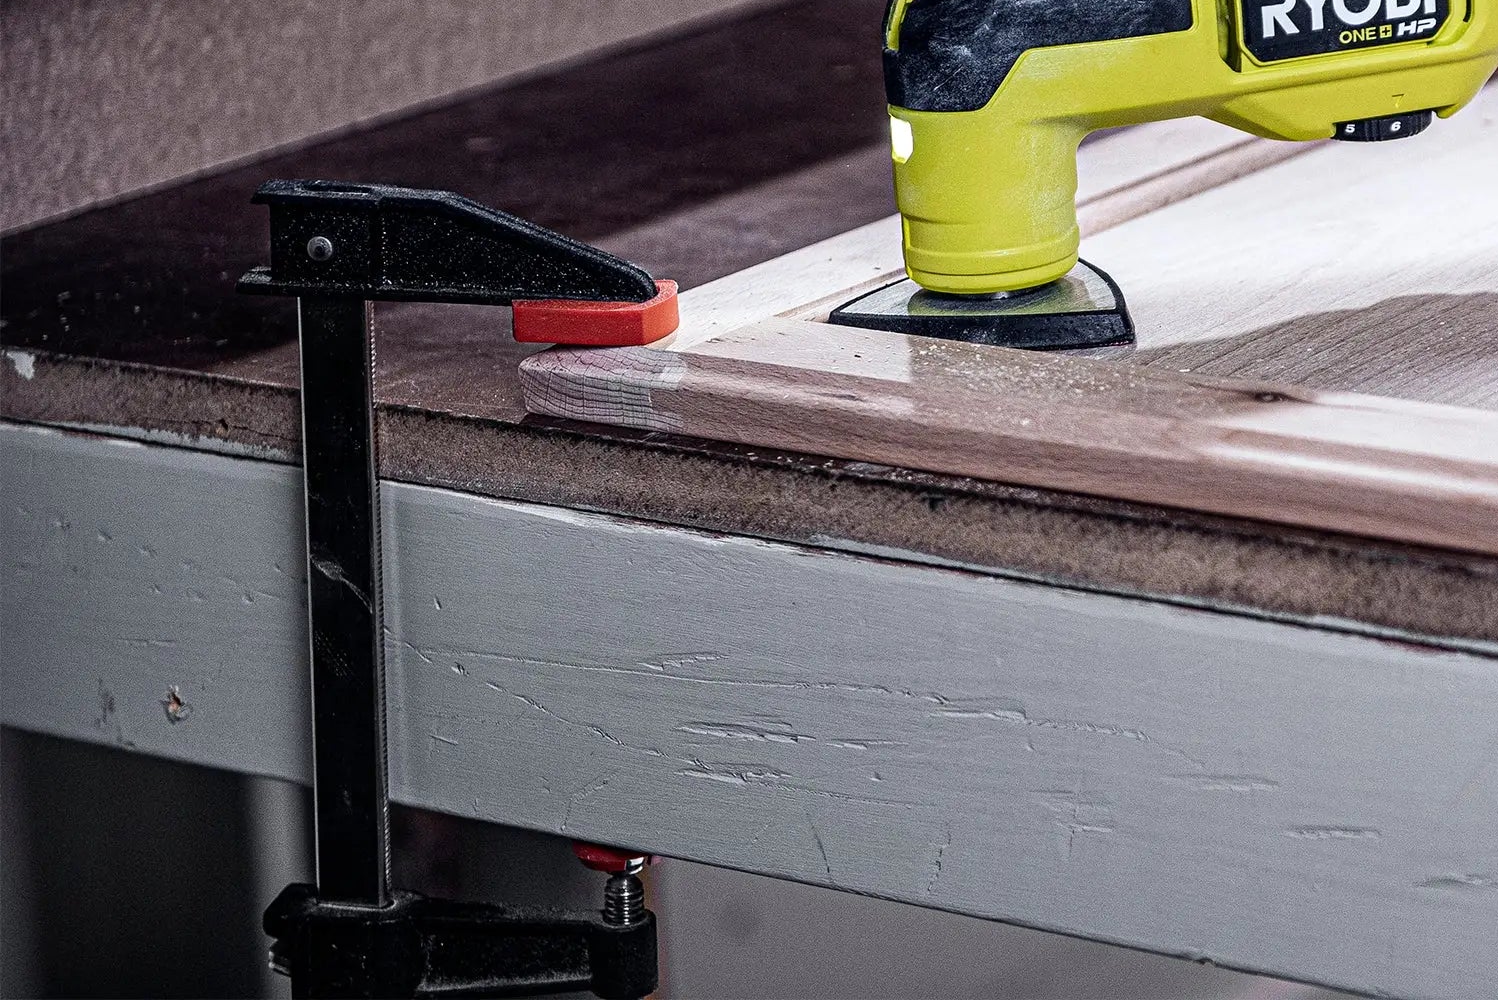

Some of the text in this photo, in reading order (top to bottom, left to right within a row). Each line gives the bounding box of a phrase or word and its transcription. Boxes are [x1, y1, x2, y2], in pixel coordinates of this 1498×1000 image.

[1397, 18, 1437, 36] HP
[1344, 121, 1402, 134] 5 6
